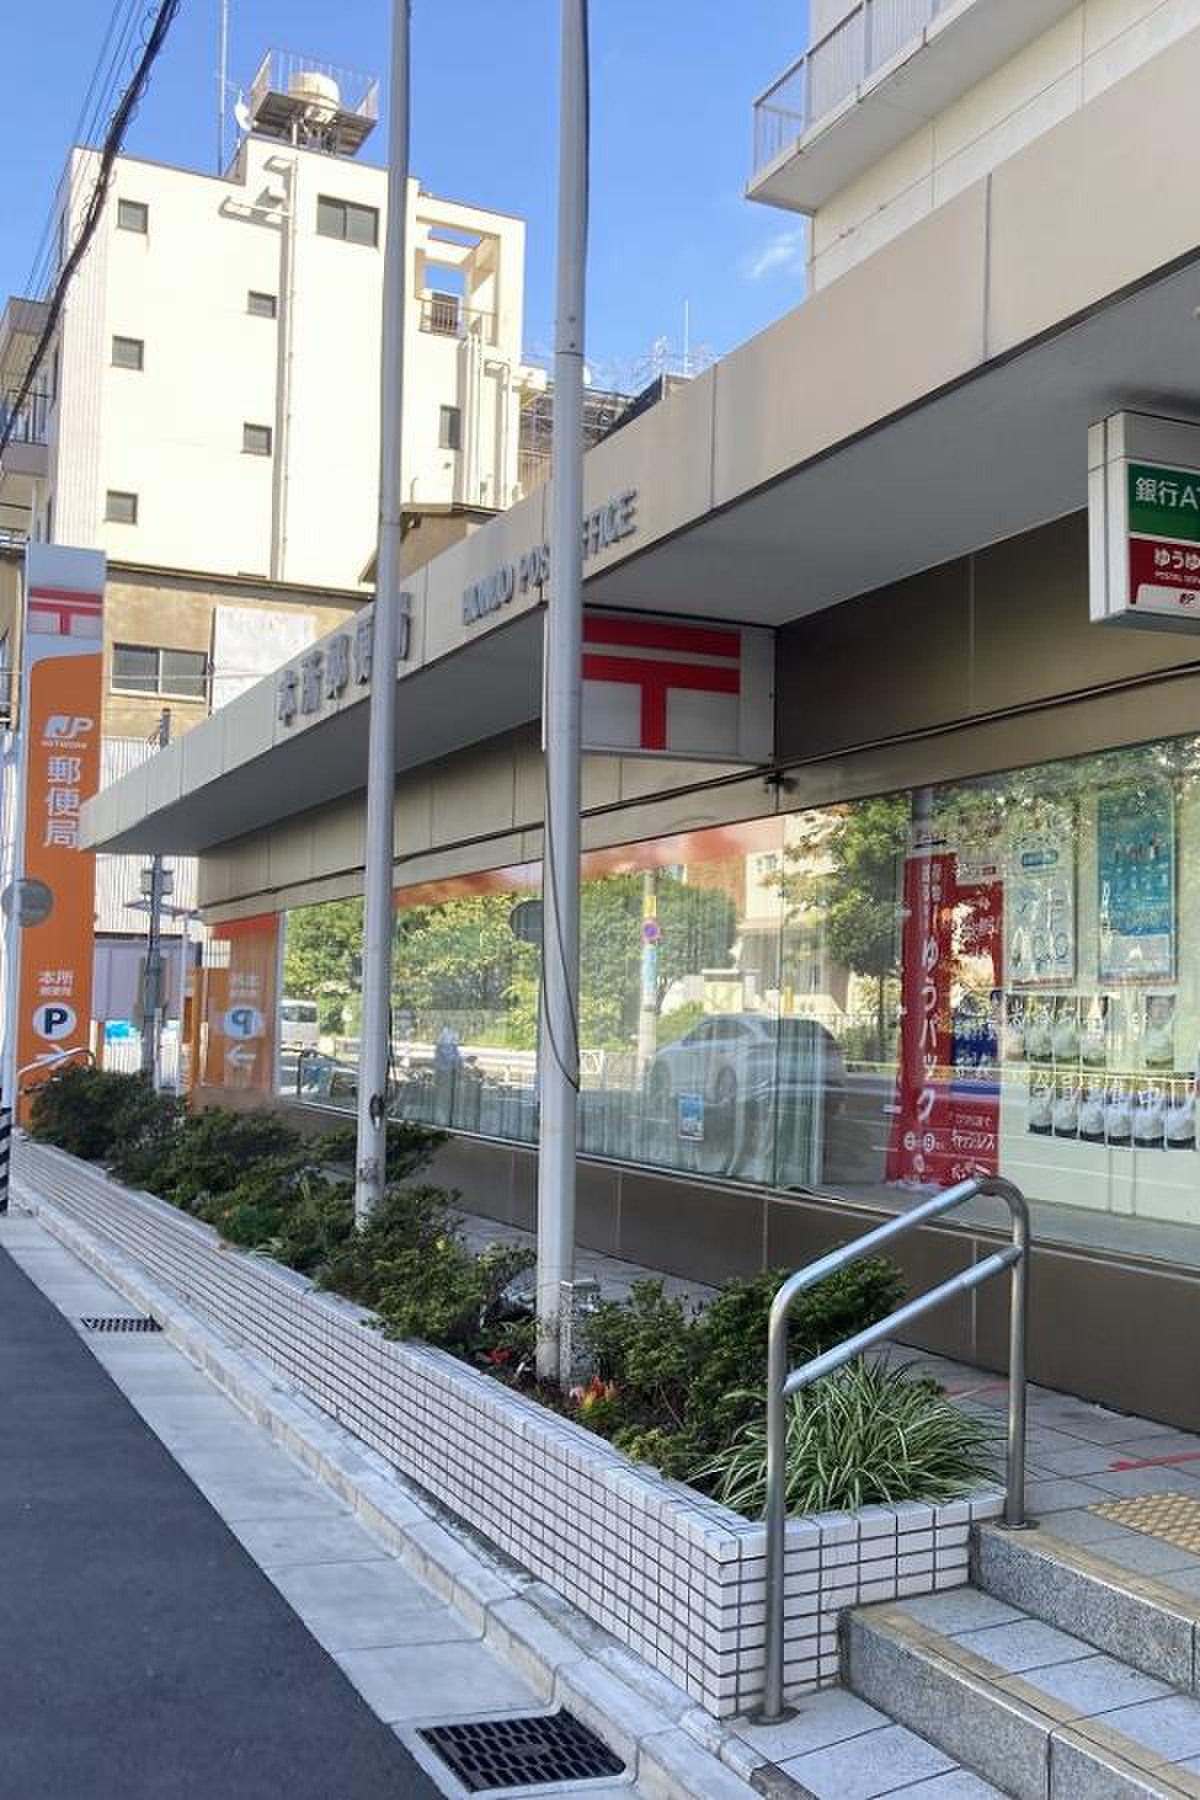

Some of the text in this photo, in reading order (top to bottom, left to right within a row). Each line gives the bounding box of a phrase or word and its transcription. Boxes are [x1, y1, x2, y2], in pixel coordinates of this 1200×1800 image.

[580, 488, 638, 562] FFICE
[43, 756, 81, 850] 郵便局
[44, 1007, 69, 1035] P
[921, 935, 940, 1121] ゆうパック
